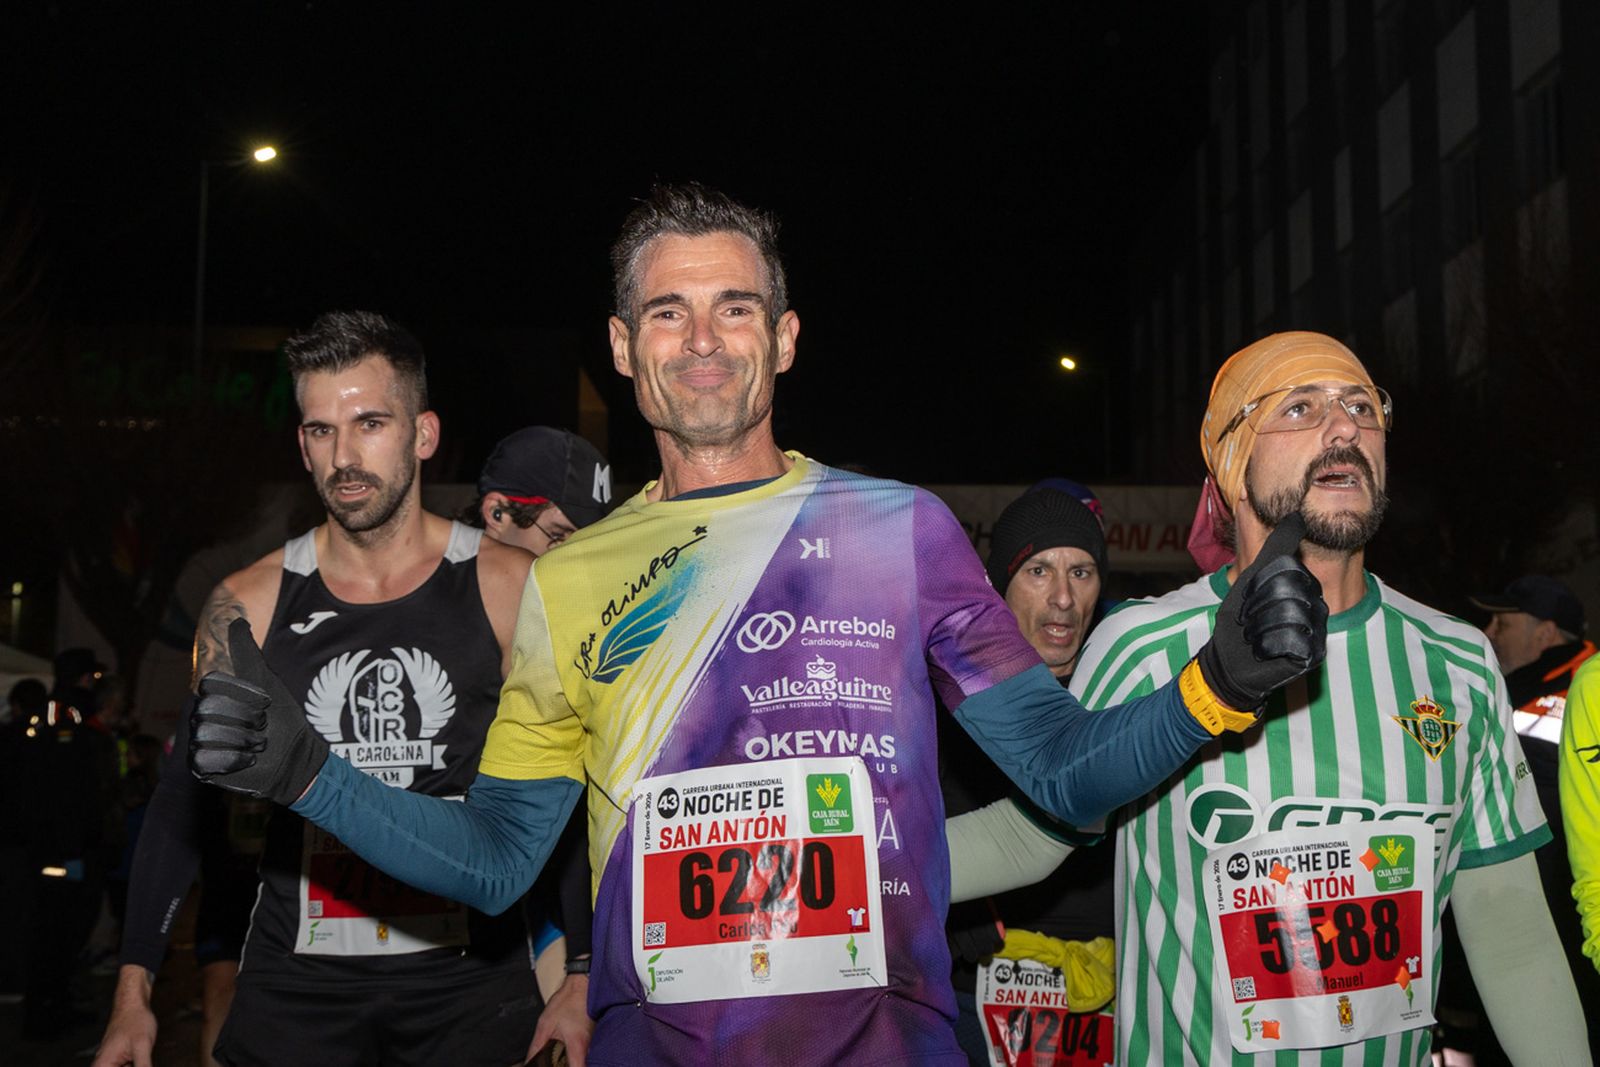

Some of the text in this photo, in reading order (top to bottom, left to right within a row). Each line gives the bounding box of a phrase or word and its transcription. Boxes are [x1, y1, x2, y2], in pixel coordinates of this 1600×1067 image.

[1107, 522, 1152, 552] AN
[801, 615, 895, 640] Arrebola
[801, 638, 879, 649] Cardiología Activa
[741, 676, 891, 701] Valleaguirre
[357, 745, 424, 763] CAROLINA
[683, 778, 783, 795] CARRERA URBANA INTERNACIONAL
[658, 794, 678, 810] 43
[683, 787, 784, 817] NOCHE DE
[645, 811, 650, 819] de
[812, 809, 849, 819] CAJA RURAL
[824, 818, 840, 827] JAÉN
[659, 811, 786, 850] SAN ANTÓN
[645, 842, 651, 850] 17
[1252, 848, 1279, 858] CARRERA
[1304, 840, 1349, 851] INTERNACIONAL
[1228, 857, 1248, 873] 43
[1326, 849, 1351, 870] DE
[679, 842, 835, 919] 6220
[879, 878, 910, 895] RÍA
[1233, 883, 1276, 909] SAN
[1254, 898, 1399, 974] 5588
[1014, 973, 1060, 988] NOCHE
[1316, 972, 1363, 992] Manuel
[995, 989, 1068, 1006] SAN ANT
